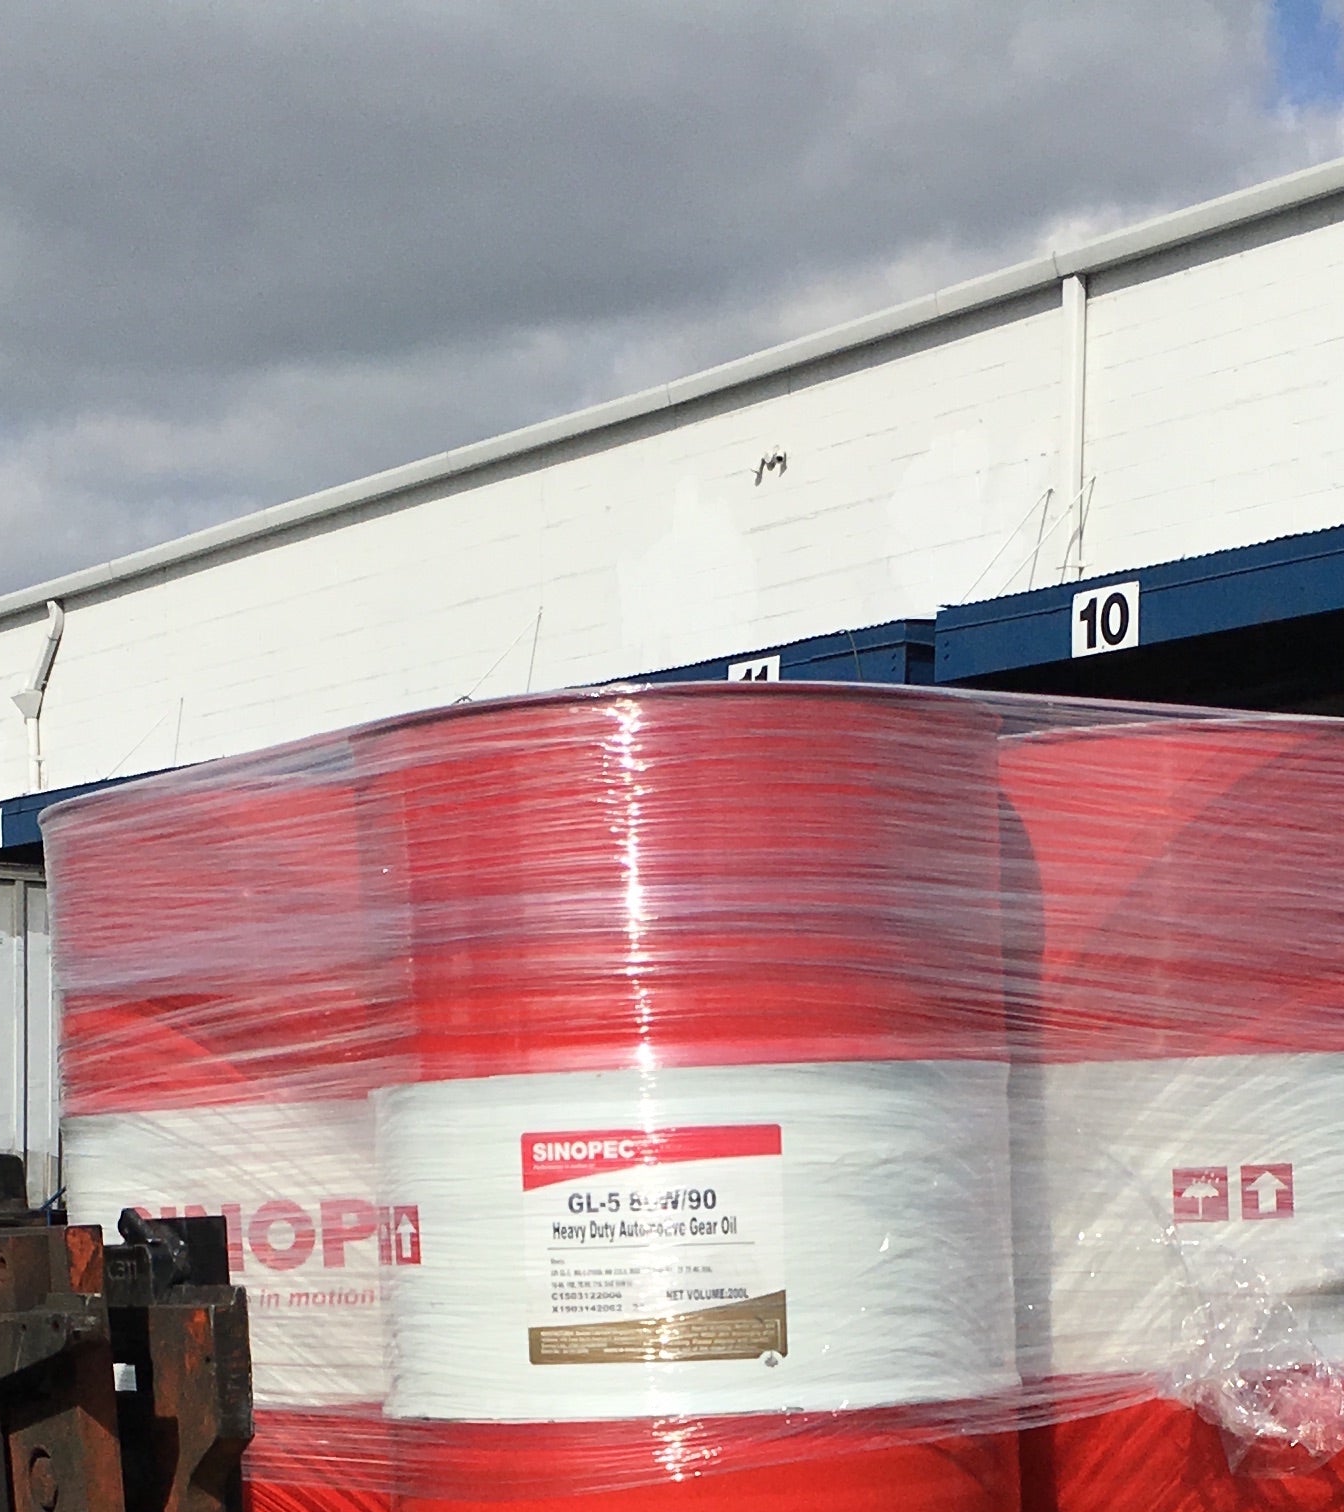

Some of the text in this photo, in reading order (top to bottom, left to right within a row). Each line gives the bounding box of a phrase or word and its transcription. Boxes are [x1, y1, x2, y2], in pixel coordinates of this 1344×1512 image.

[1079, 591, 1129, 649] 10
[532, 1139, 635, 1162] SINOPEC
[568, 1188, 717, 1214] GL-5 8W/90
[552, 1215, 738, 1243] Heavy Duty Autoove Gear Oil
[259, 1287, 375, 1308] in motion
